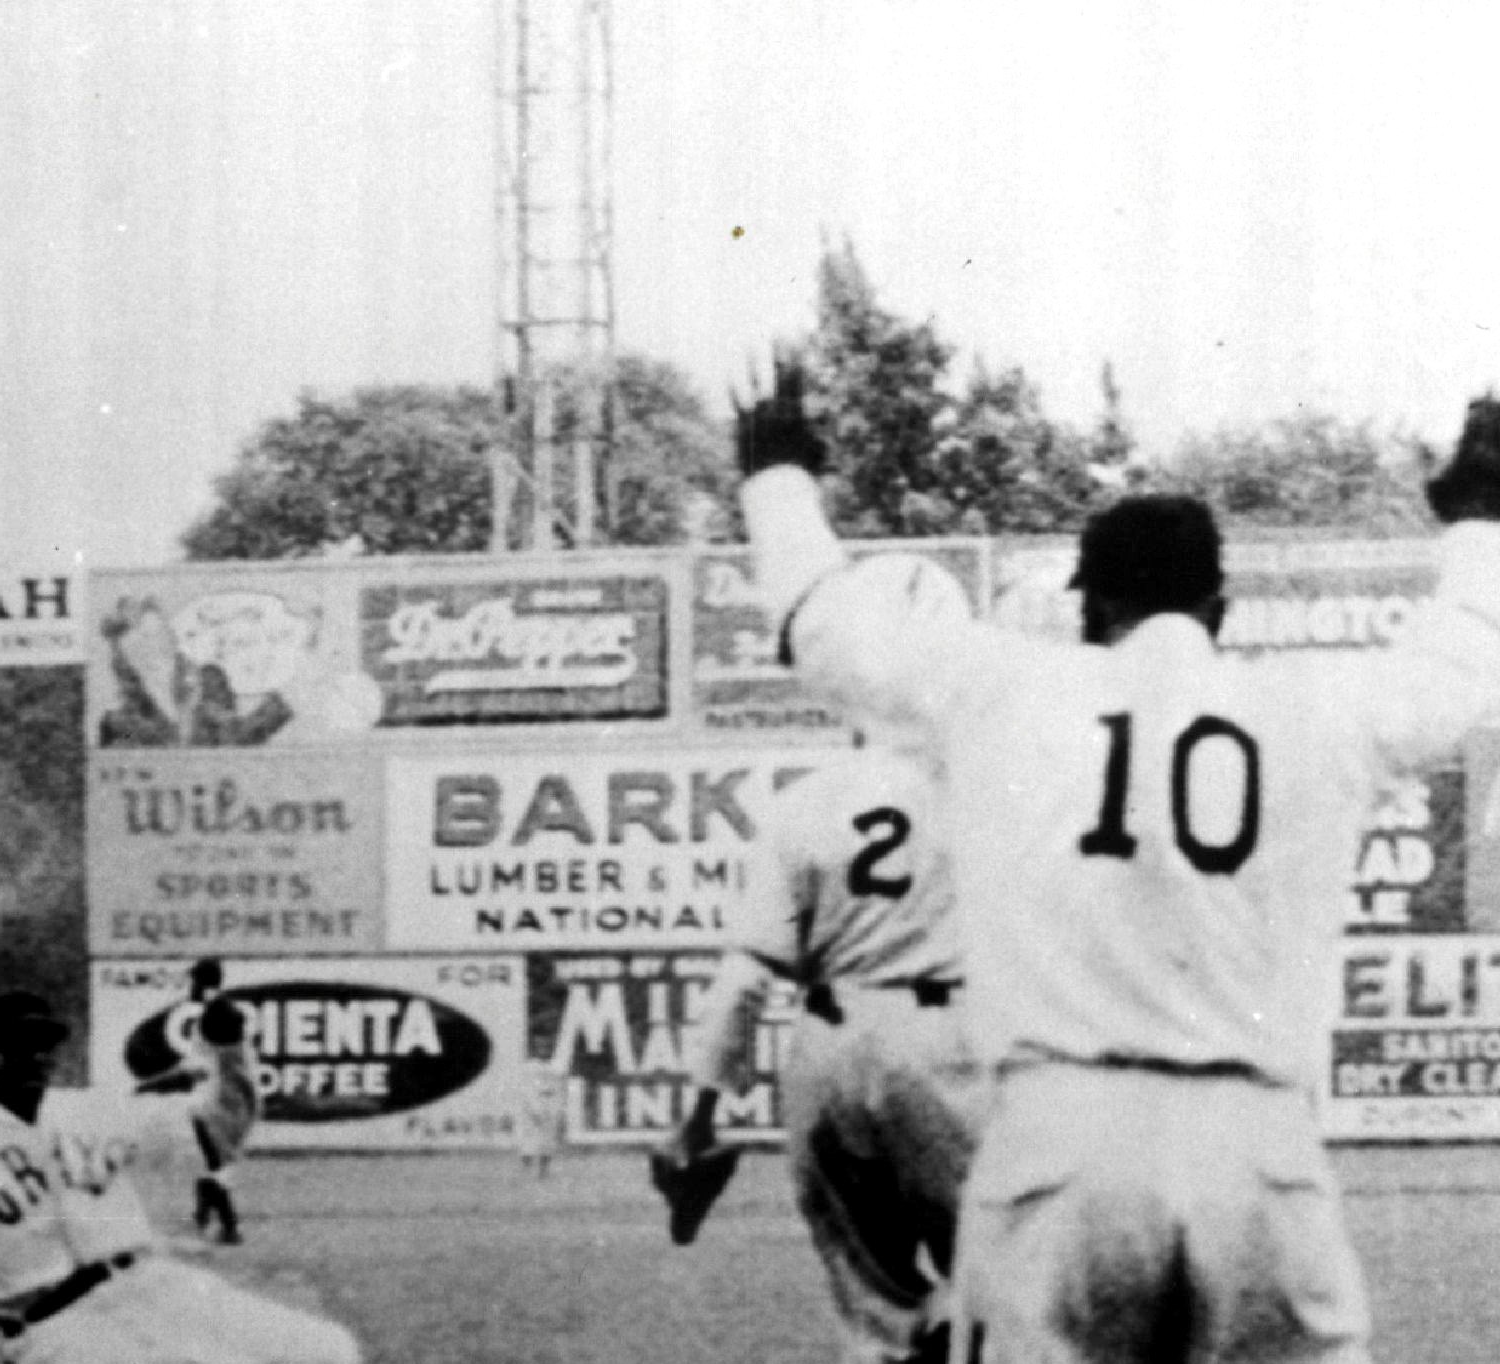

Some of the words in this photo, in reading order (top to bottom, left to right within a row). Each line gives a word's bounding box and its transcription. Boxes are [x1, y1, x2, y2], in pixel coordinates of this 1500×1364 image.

[121, 776, 354, 836] Wilson
[433, 767, 814, 848] BARK
[1078, 711, 1262, 877] 10
[430, 858, 624, 896] LUMBER
[845, 806, 913, 900] 2
[109, 908, 359, 945] EQUIPMENT
[437, 967, 513, 988] FOR
[1343, 954, 1500, 1019] ELI
[256, 1062, 392, 1097] OFFEE
